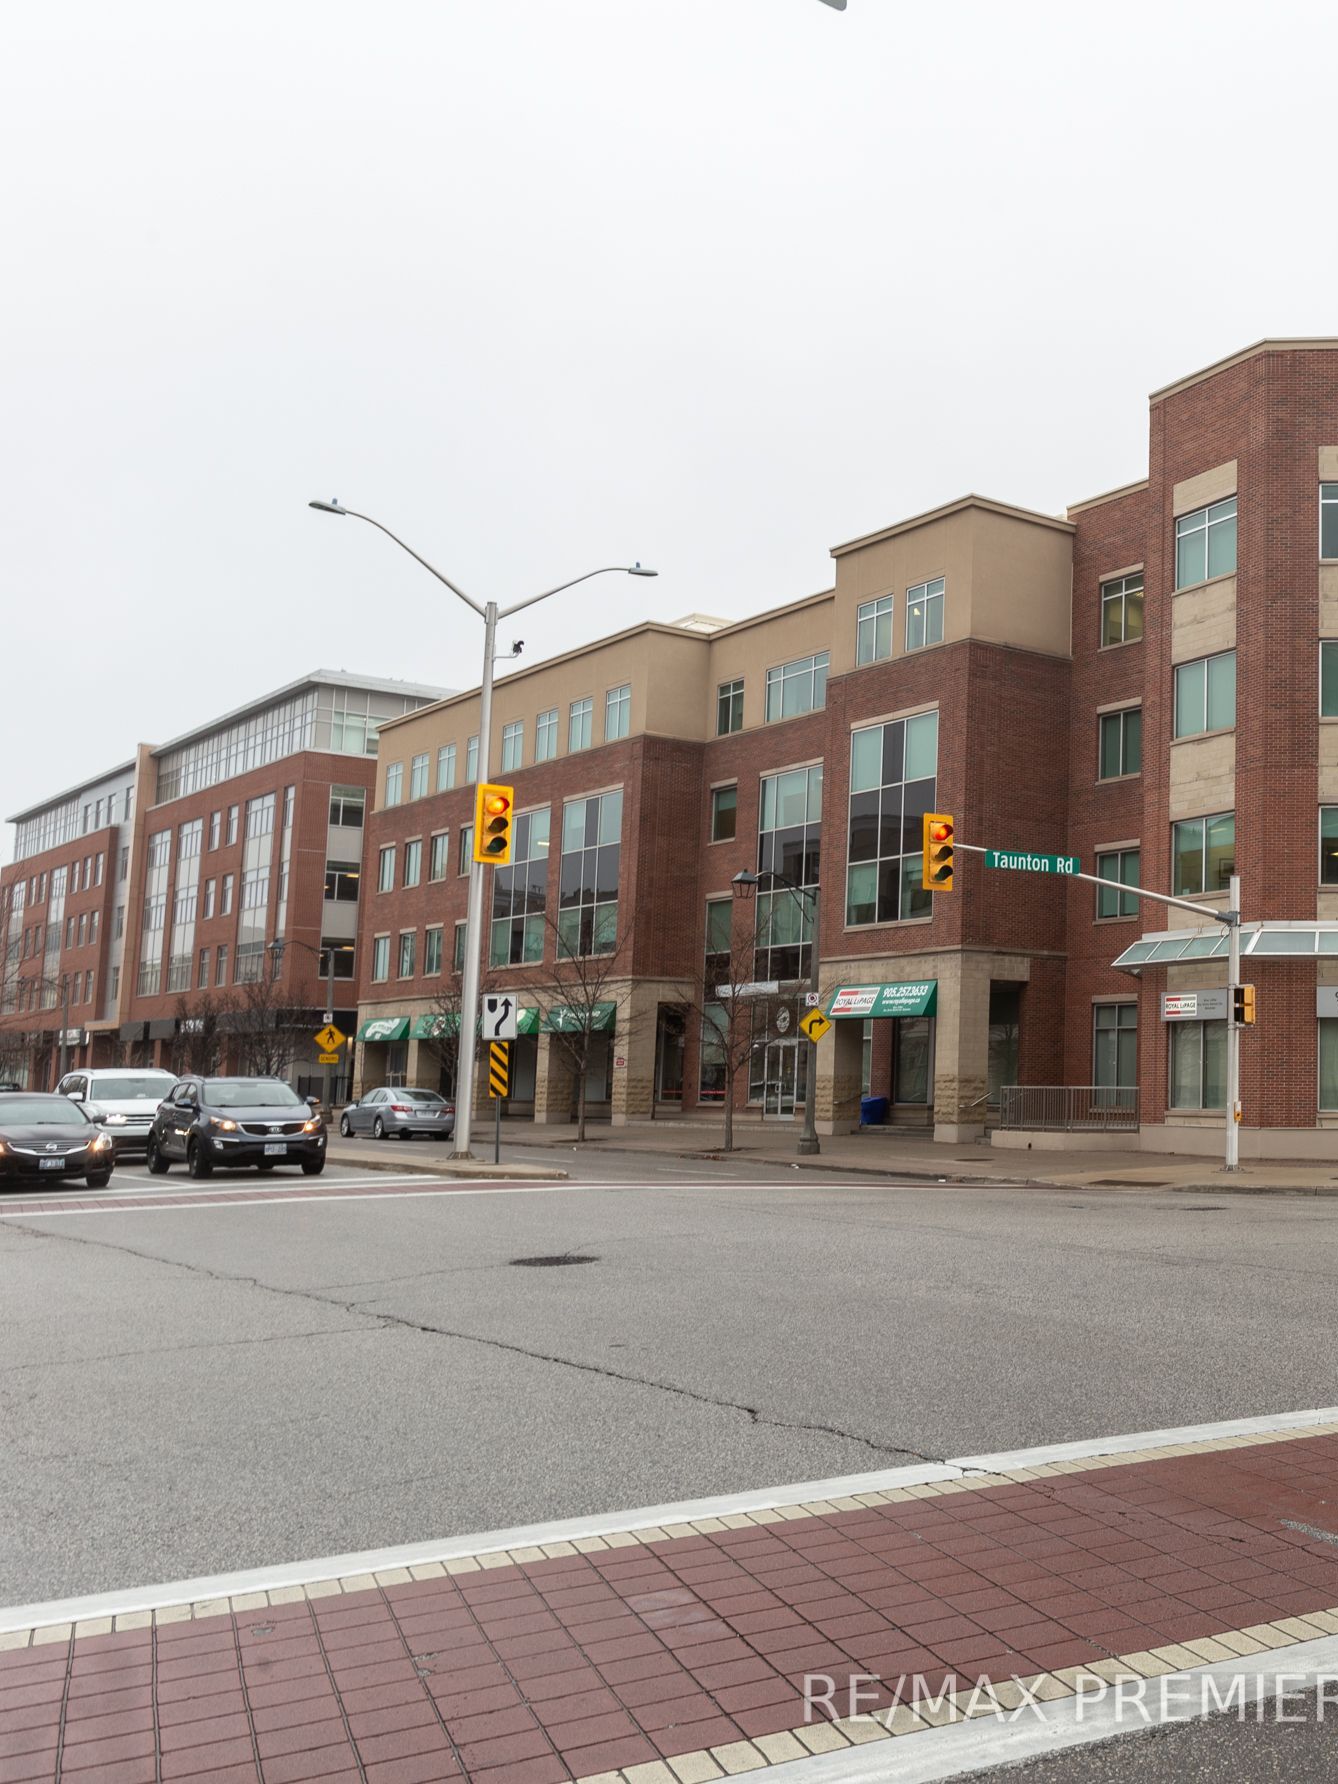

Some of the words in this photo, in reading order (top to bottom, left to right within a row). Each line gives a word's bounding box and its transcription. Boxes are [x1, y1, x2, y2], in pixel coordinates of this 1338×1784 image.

[993, 852, 1049, 872] Taunton
[1056, 857, 1073, 874] Rd
[883, 985, 928, 998] 905.257.3633
